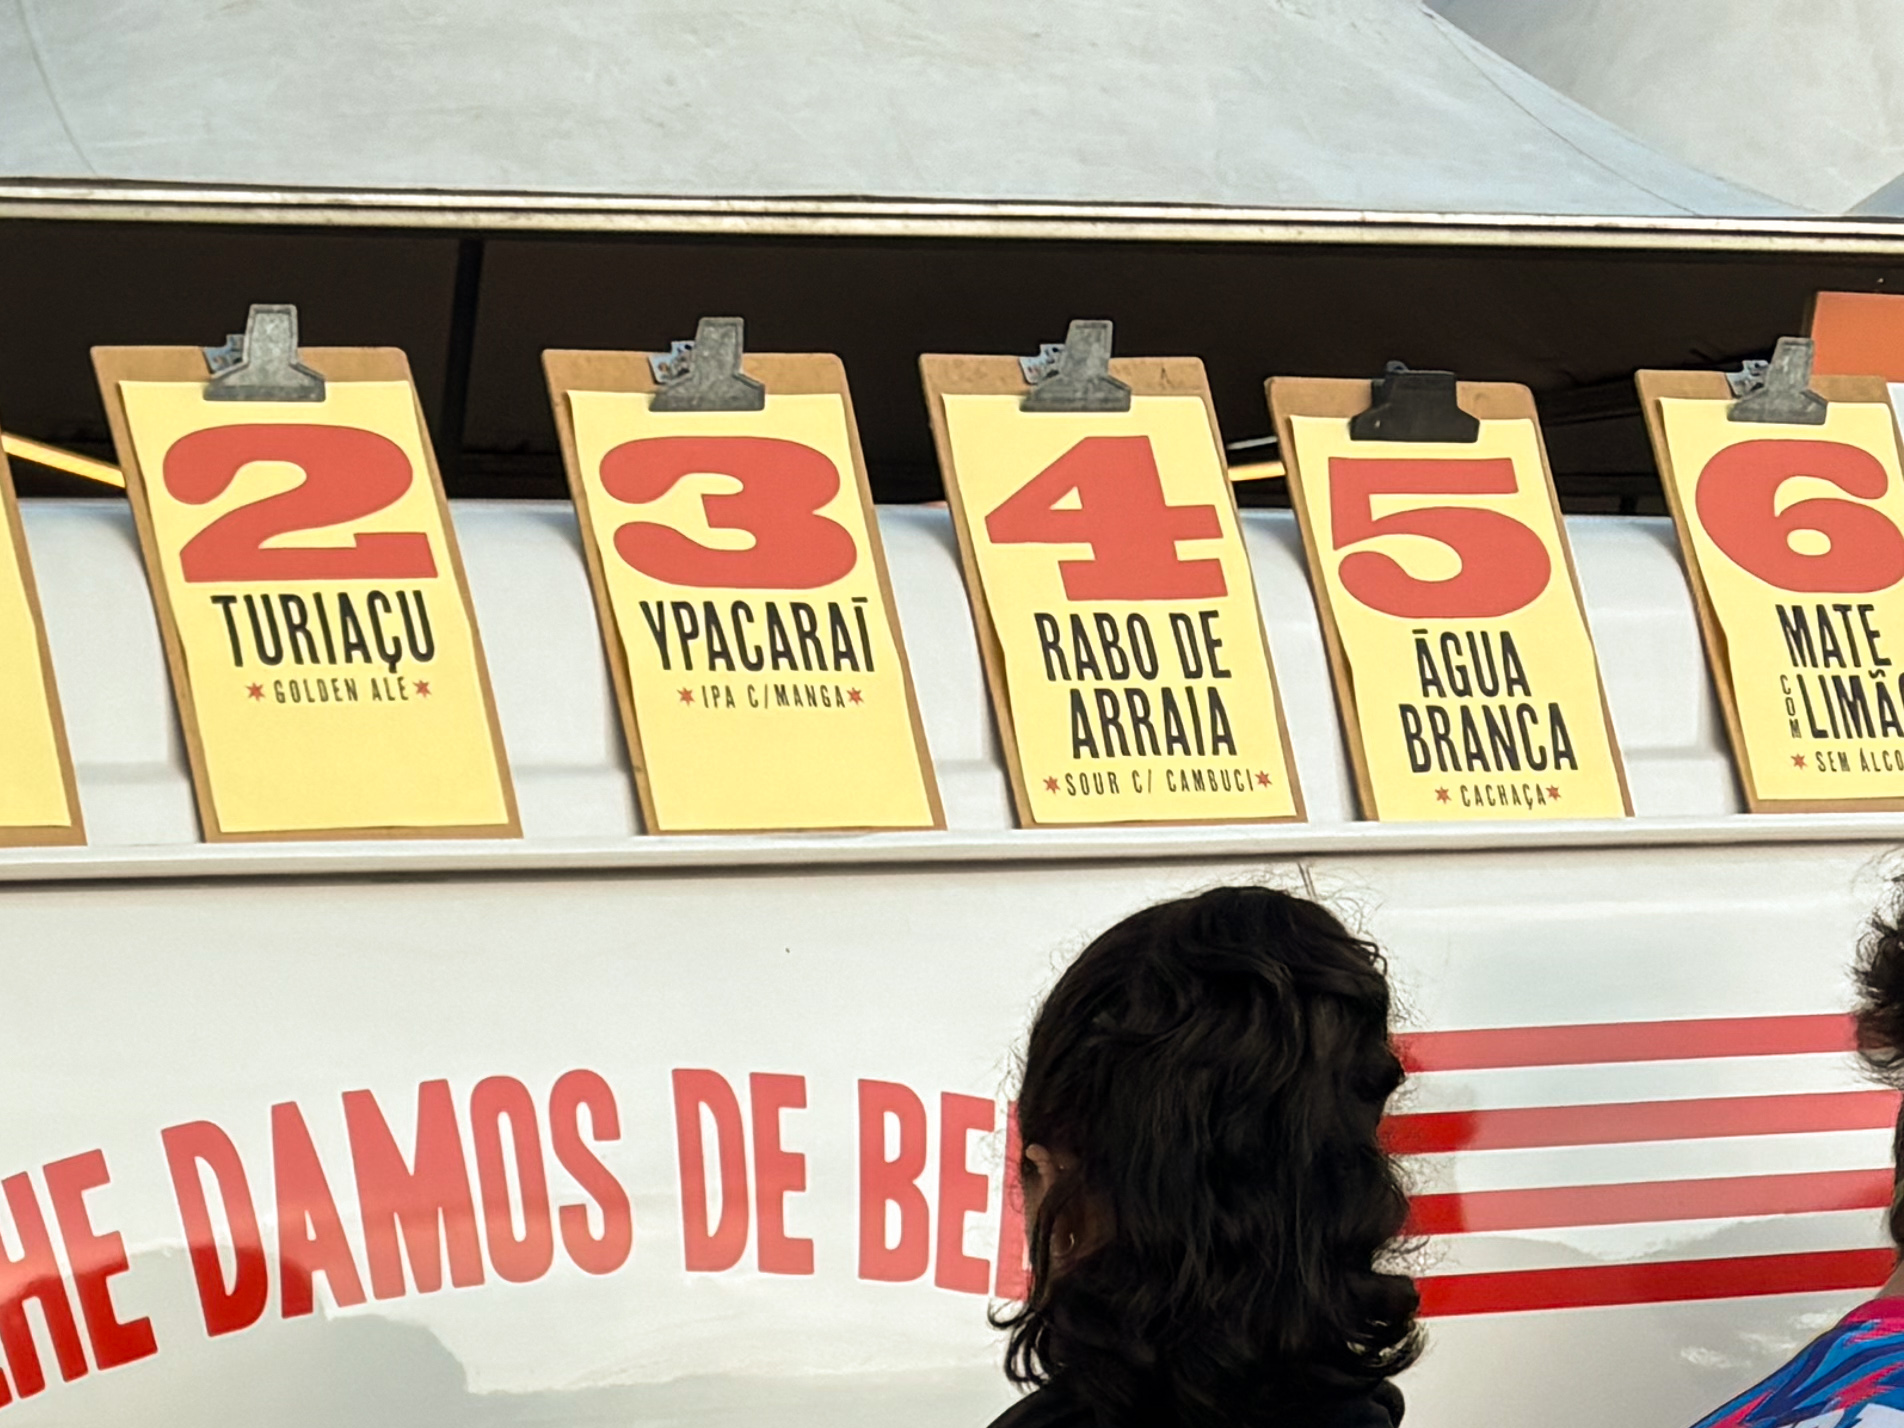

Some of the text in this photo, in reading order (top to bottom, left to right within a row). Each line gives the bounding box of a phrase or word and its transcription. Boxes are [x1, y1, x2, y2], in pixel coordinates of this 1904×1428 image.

[162, 422, 440, 583] 2
[599, 434, 859, 592] 3
[984, 434, 1230, 603] 4
[1327, 456, 1552, 620] 5
[1694, 438, 1904, 594] 6
[212, 590, 438, 675] TURIAÇU
[1034, 609, 1234, 683] RABO DE
[1775, 604, 1892, 668] MATE
[274, 677, 411, 706] GOLDEN ALE
[702, 684, 736, 708] IPA
[1070, 687, 1239, 761] ARRAIA
[1399, 702, 1578, 773] BRANCA
[1815, 751, 1850, 772] SEM
[1063, 767, 1257, 798] SOUR C/ CAMBUCI
[1460, 783, 1547, 810] CACHAÇA
[160, 1068, 634, 1341] DAMOS
[671, 1067, 817, 1275] DE
